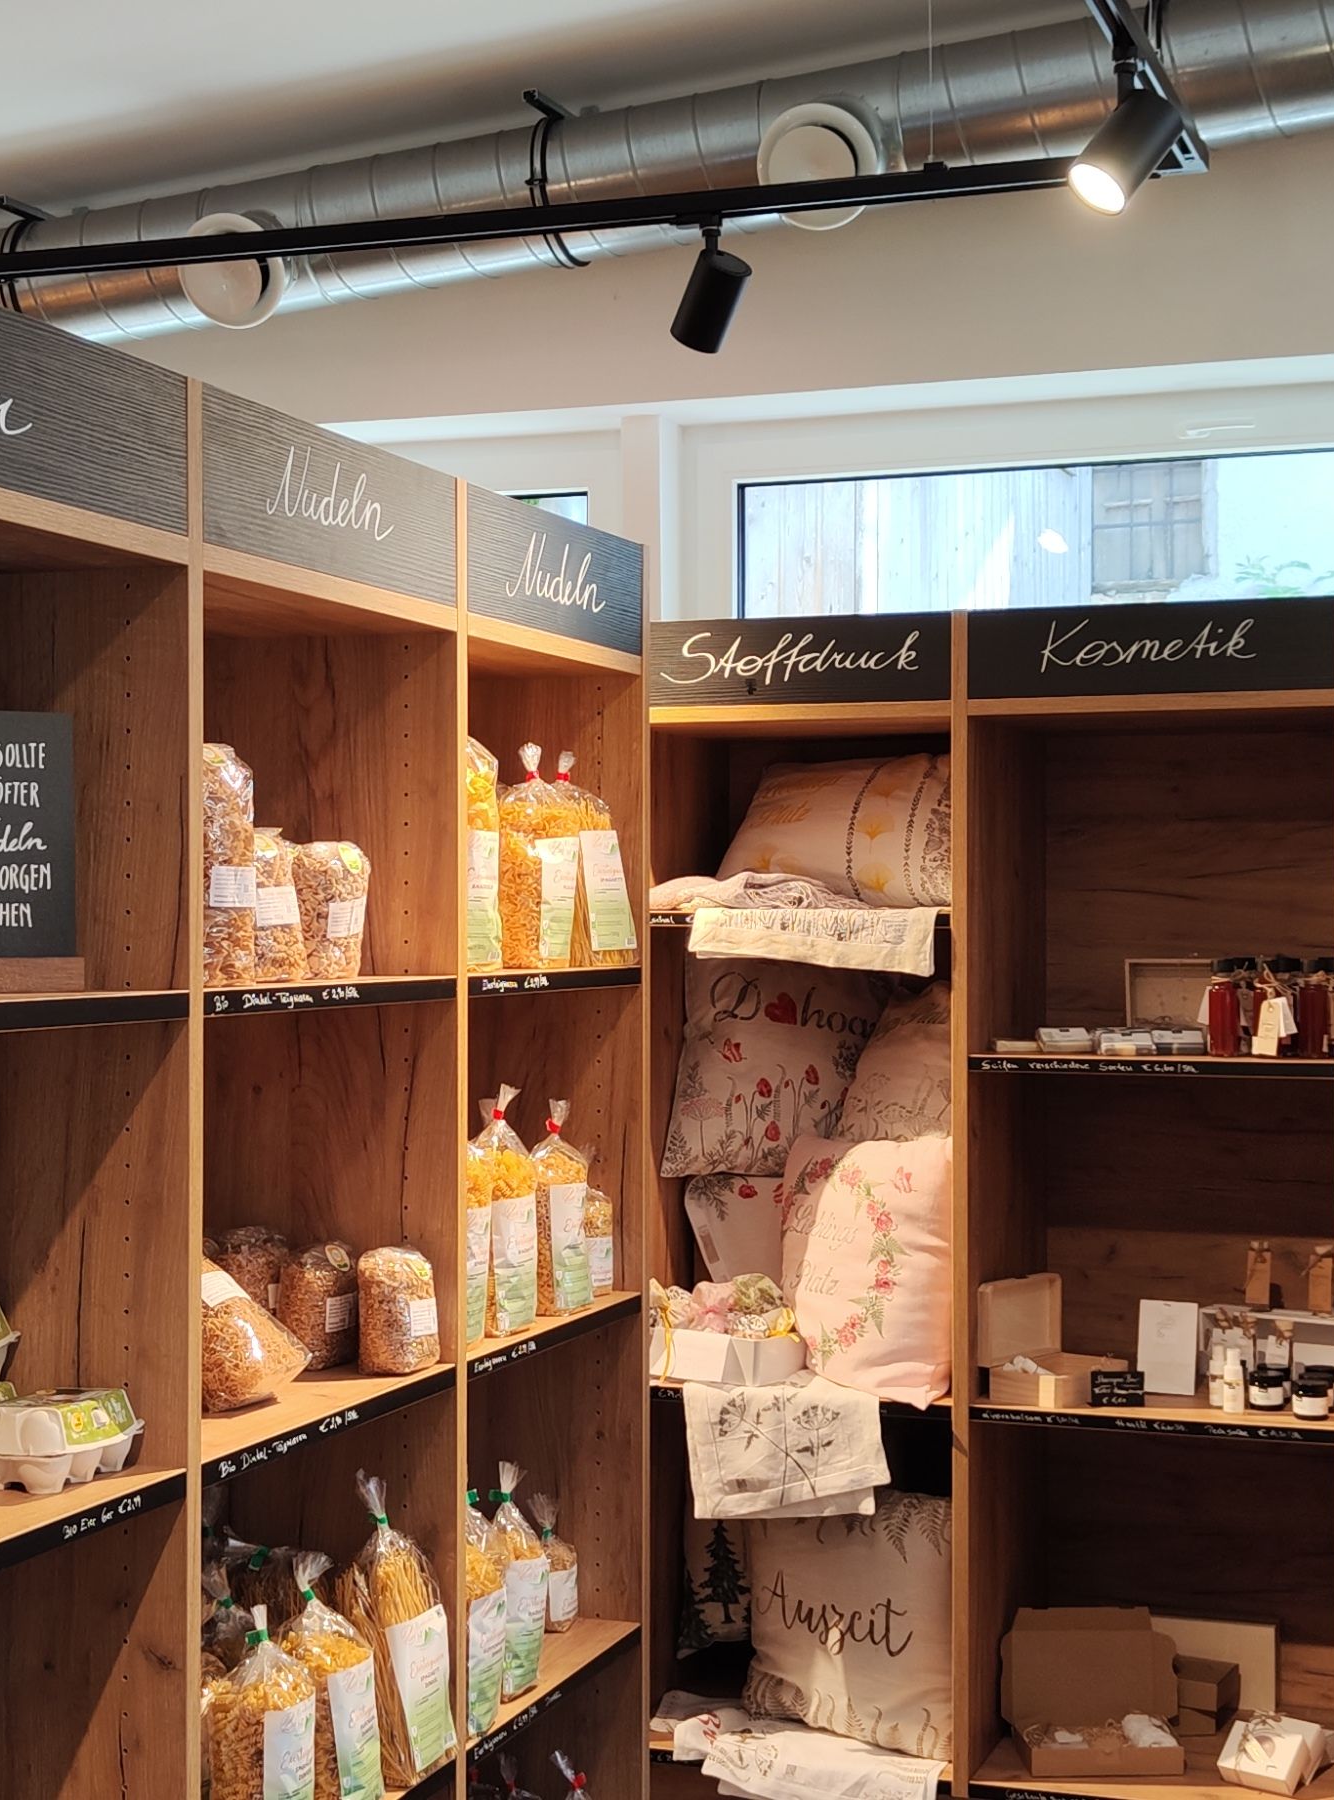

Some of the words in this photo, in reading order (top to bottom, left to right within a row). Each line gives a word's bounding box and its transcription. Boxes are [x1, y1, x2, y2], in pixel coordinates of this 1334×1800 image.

[267, 445, 395, 541] Nudeln
[506, 532, 606, 613] Nudeln
[661, 631, 920, 684] Stoffdruck
[1039, 618, 1259, 672] Kosmetik
[790, 1259, 840, 1296] Platz
[756, 1568, 914, 1658] Auszeit
